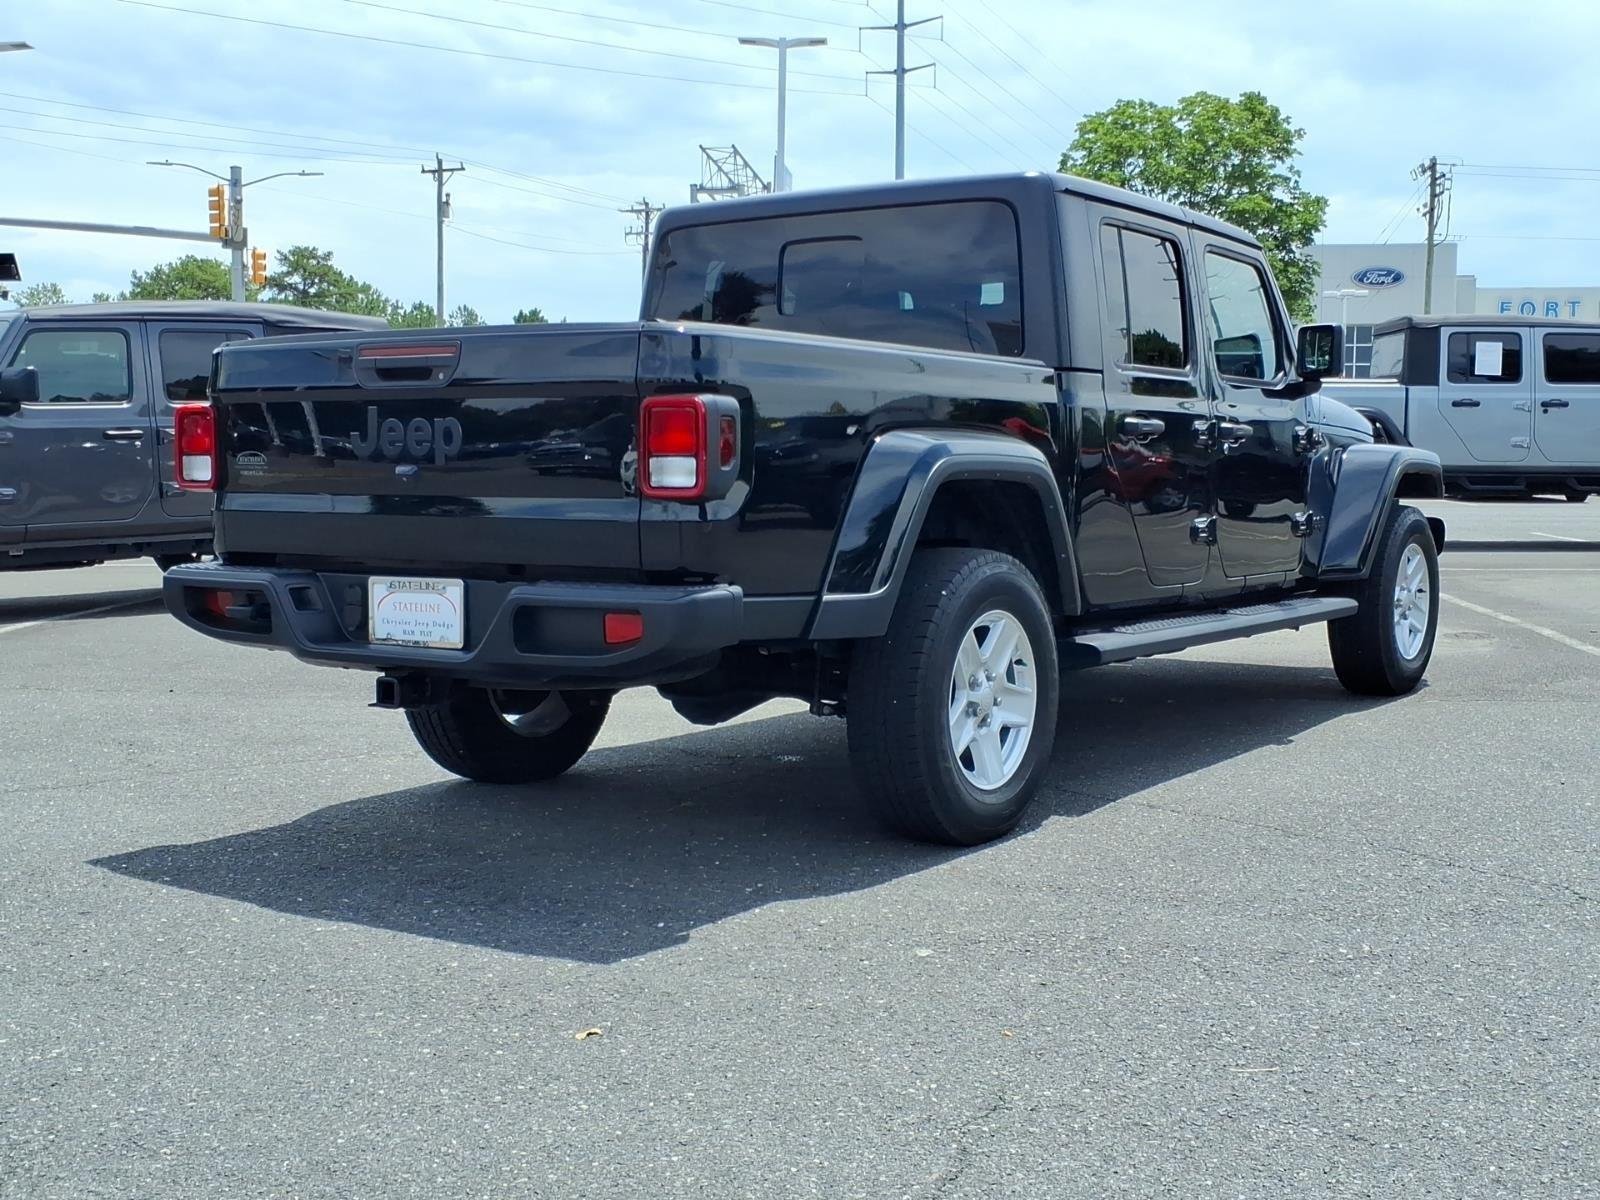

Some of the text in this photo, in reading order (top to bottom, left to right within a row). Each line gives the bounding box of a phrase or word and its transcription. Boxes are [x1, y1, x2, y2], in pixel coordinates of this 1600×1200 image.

[1363, 270, 1395, 284] Ford
[1500, 301, 1581, 318] FORT
[350, 405, 462, 465] Jeep
[392, 601, 441, 614] STATELINE
